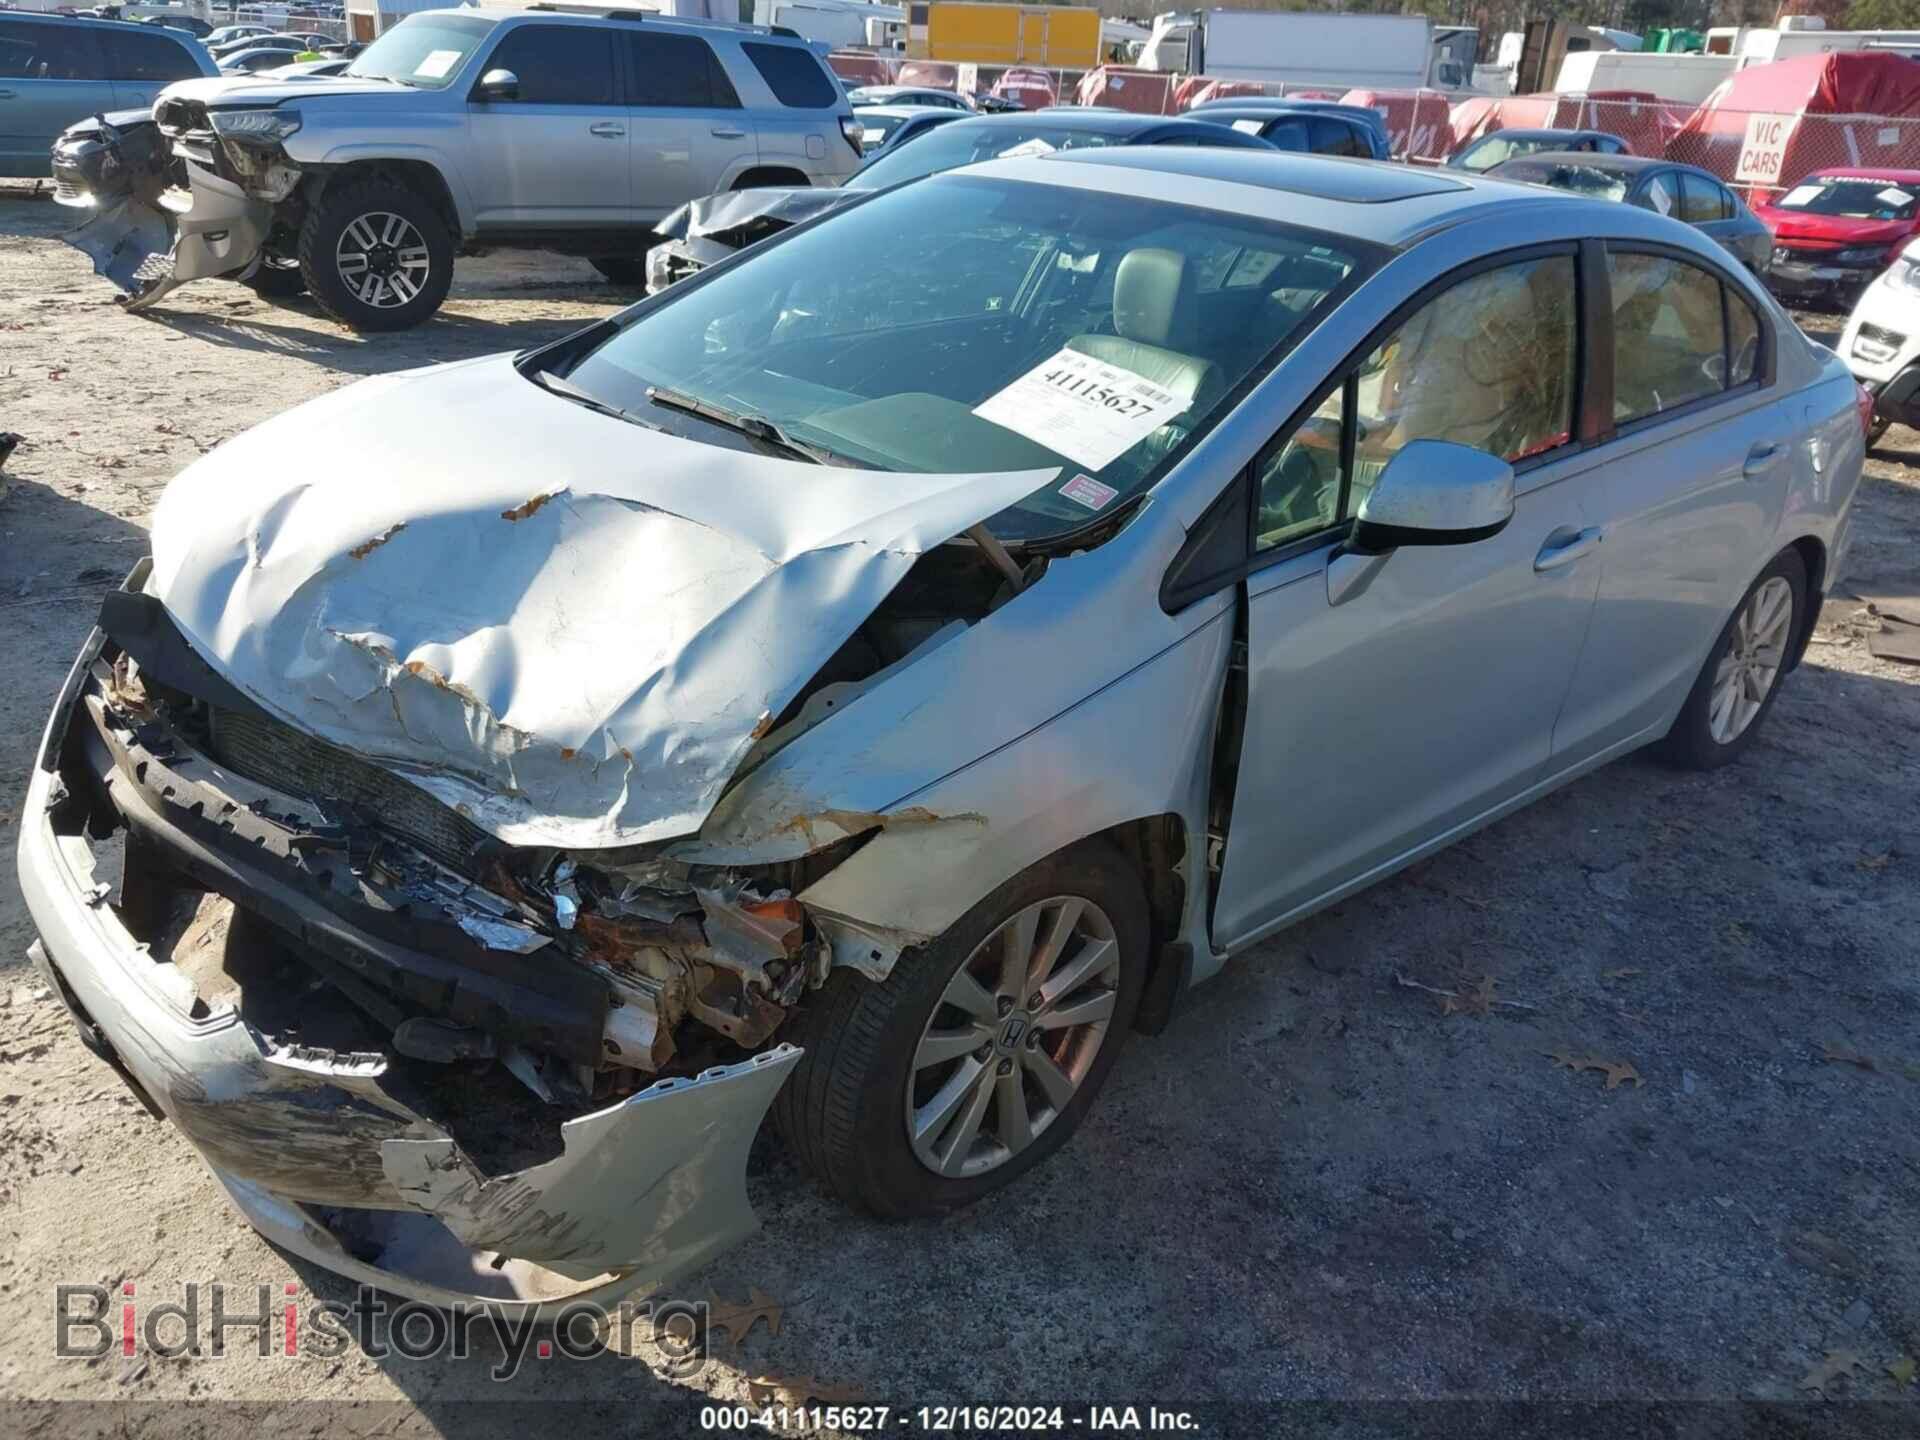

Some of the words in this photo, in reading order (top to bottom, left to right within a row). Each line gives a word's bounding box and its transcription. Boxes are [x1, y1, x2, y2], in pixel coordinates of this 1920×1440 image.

[1756, 121, 1781, 144] VIC
[1743, 150, 1779, 174] CARS
[1044, 370, 1153, 419] 41115627
